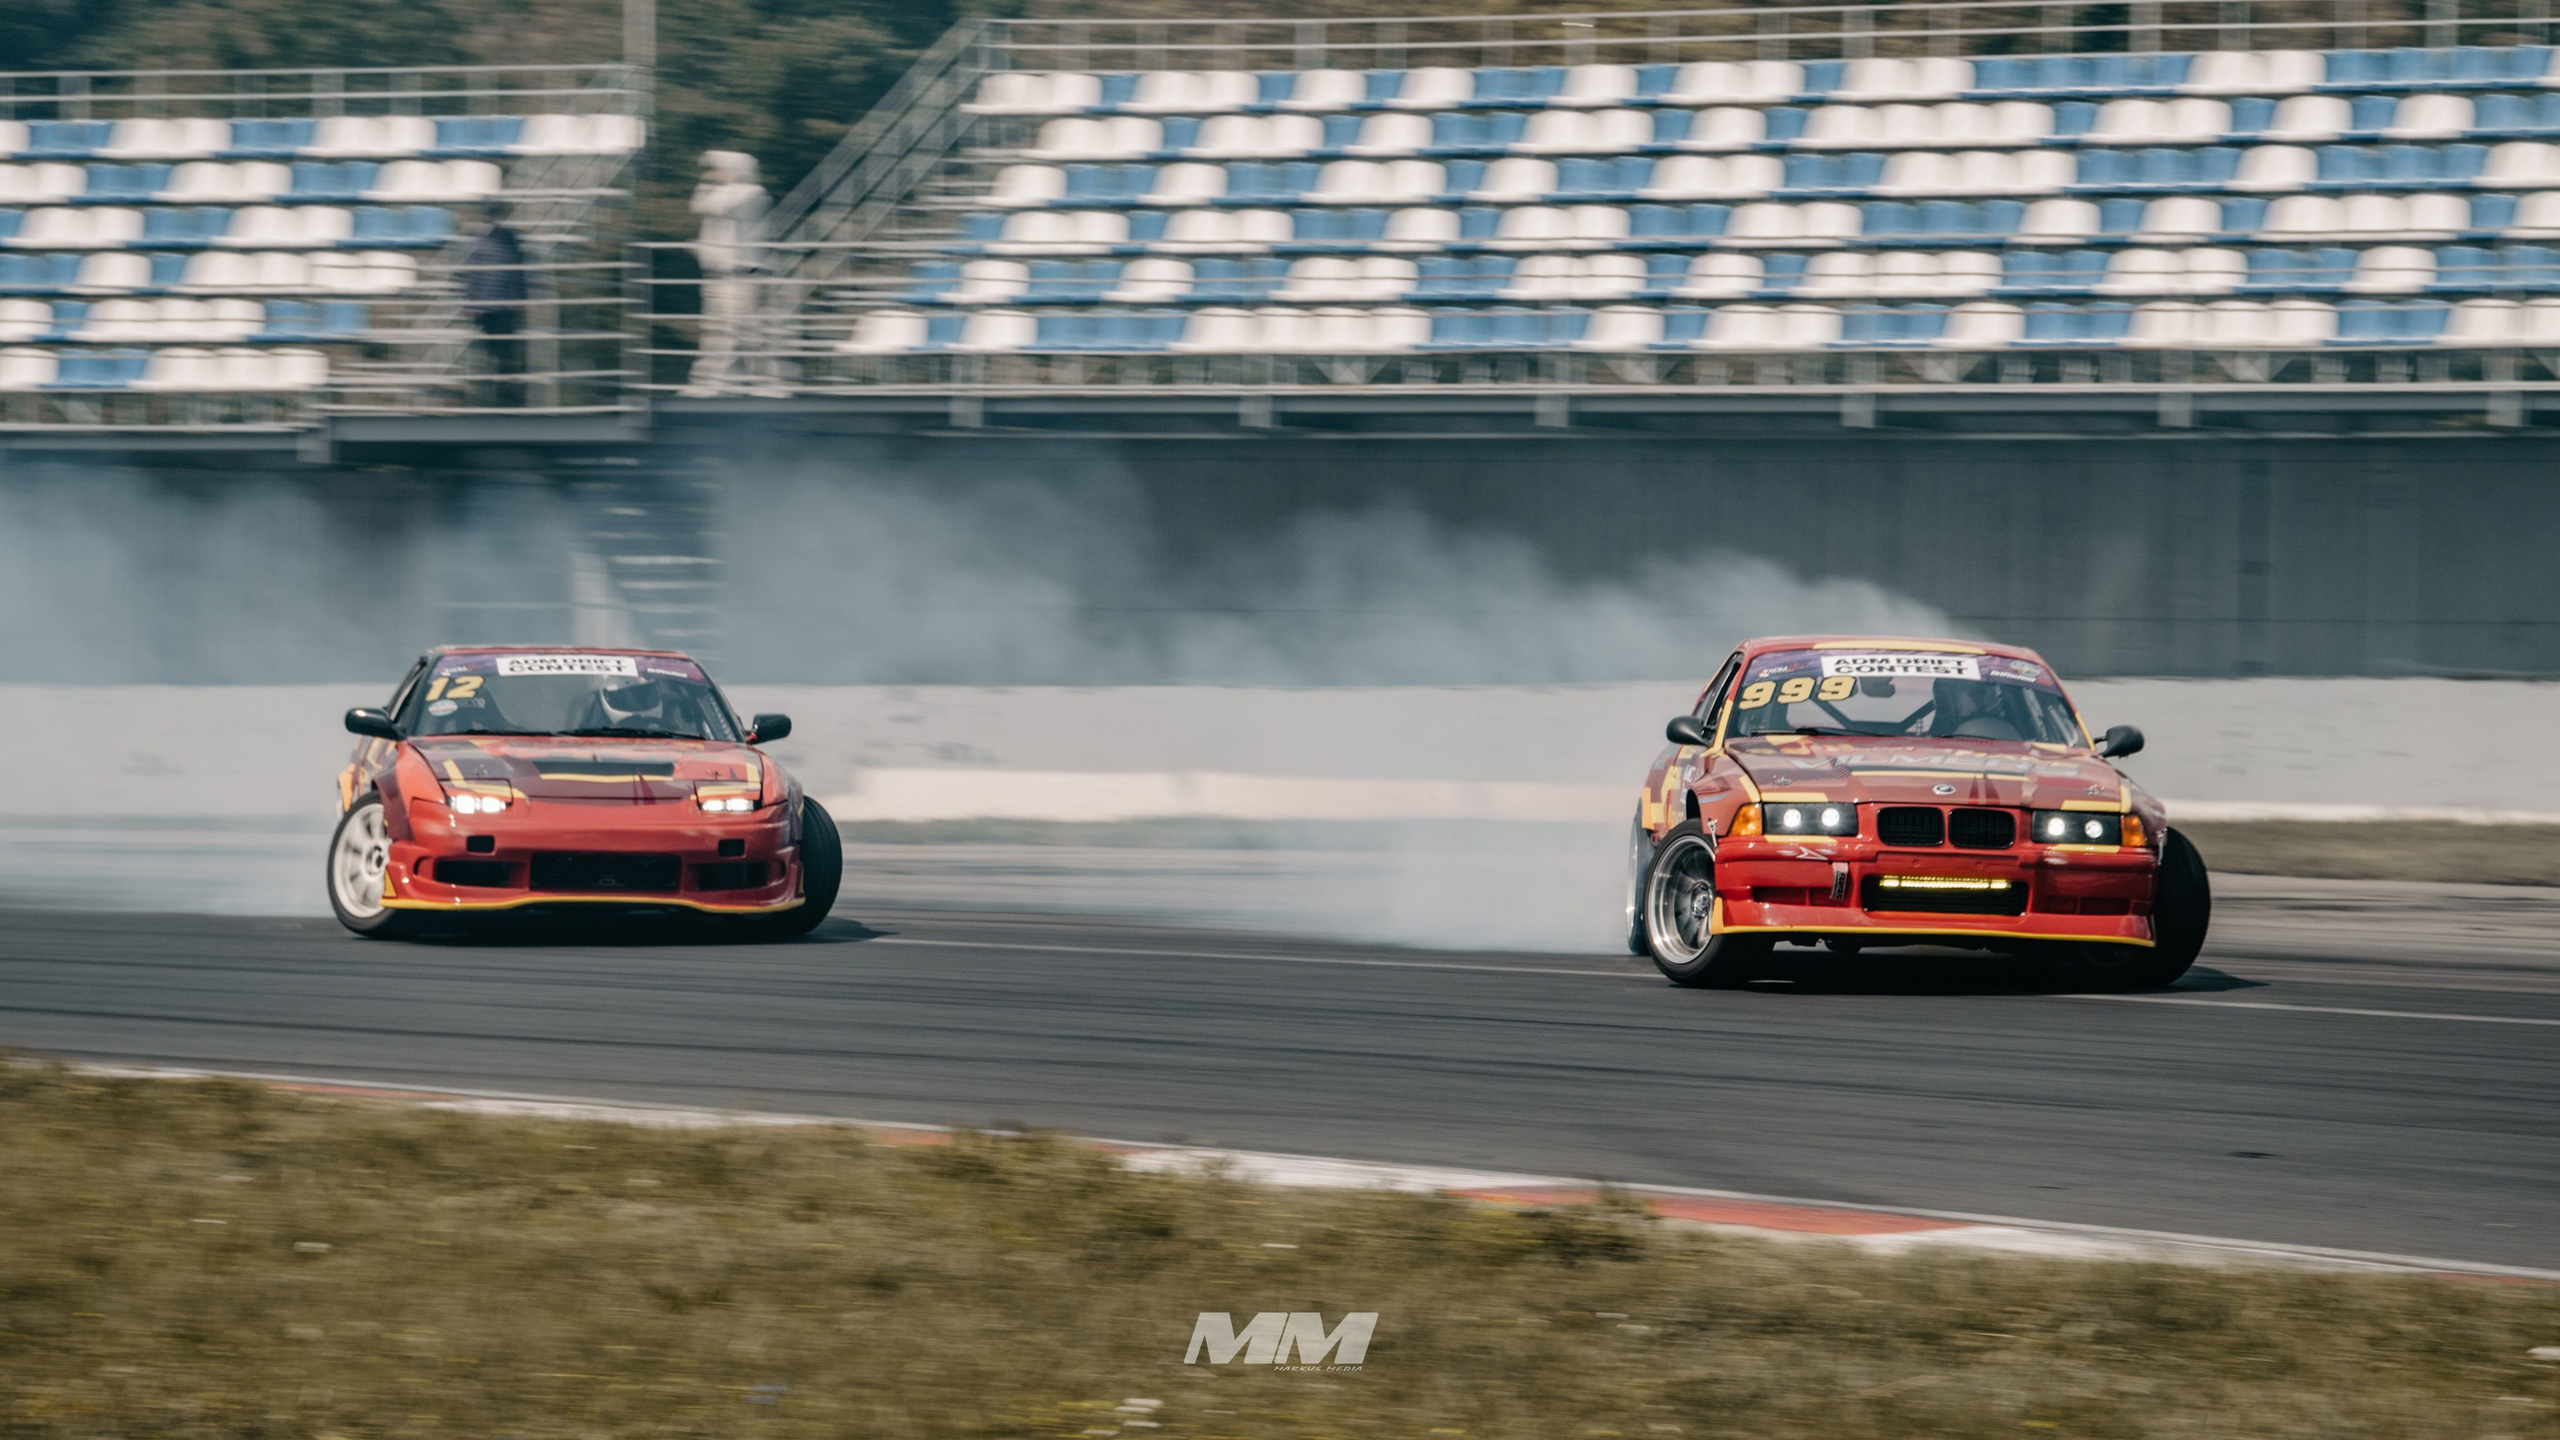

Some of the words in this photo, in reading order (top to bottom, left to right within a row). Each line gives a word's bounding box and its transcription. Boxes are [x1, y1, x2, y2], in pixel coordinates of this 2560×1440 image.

[563, 658, 625, 666] DRIFT
[1835, 657, 1890, 665] ADM
[1895, 657, 1967, 666] DRIFT
[508, 665, 627, 673] CONTEST
[1834, 665, 1968, 675] CONTEST
[425, 674, 485, 702] 12
[1738, 676, 1856, 710] 999
